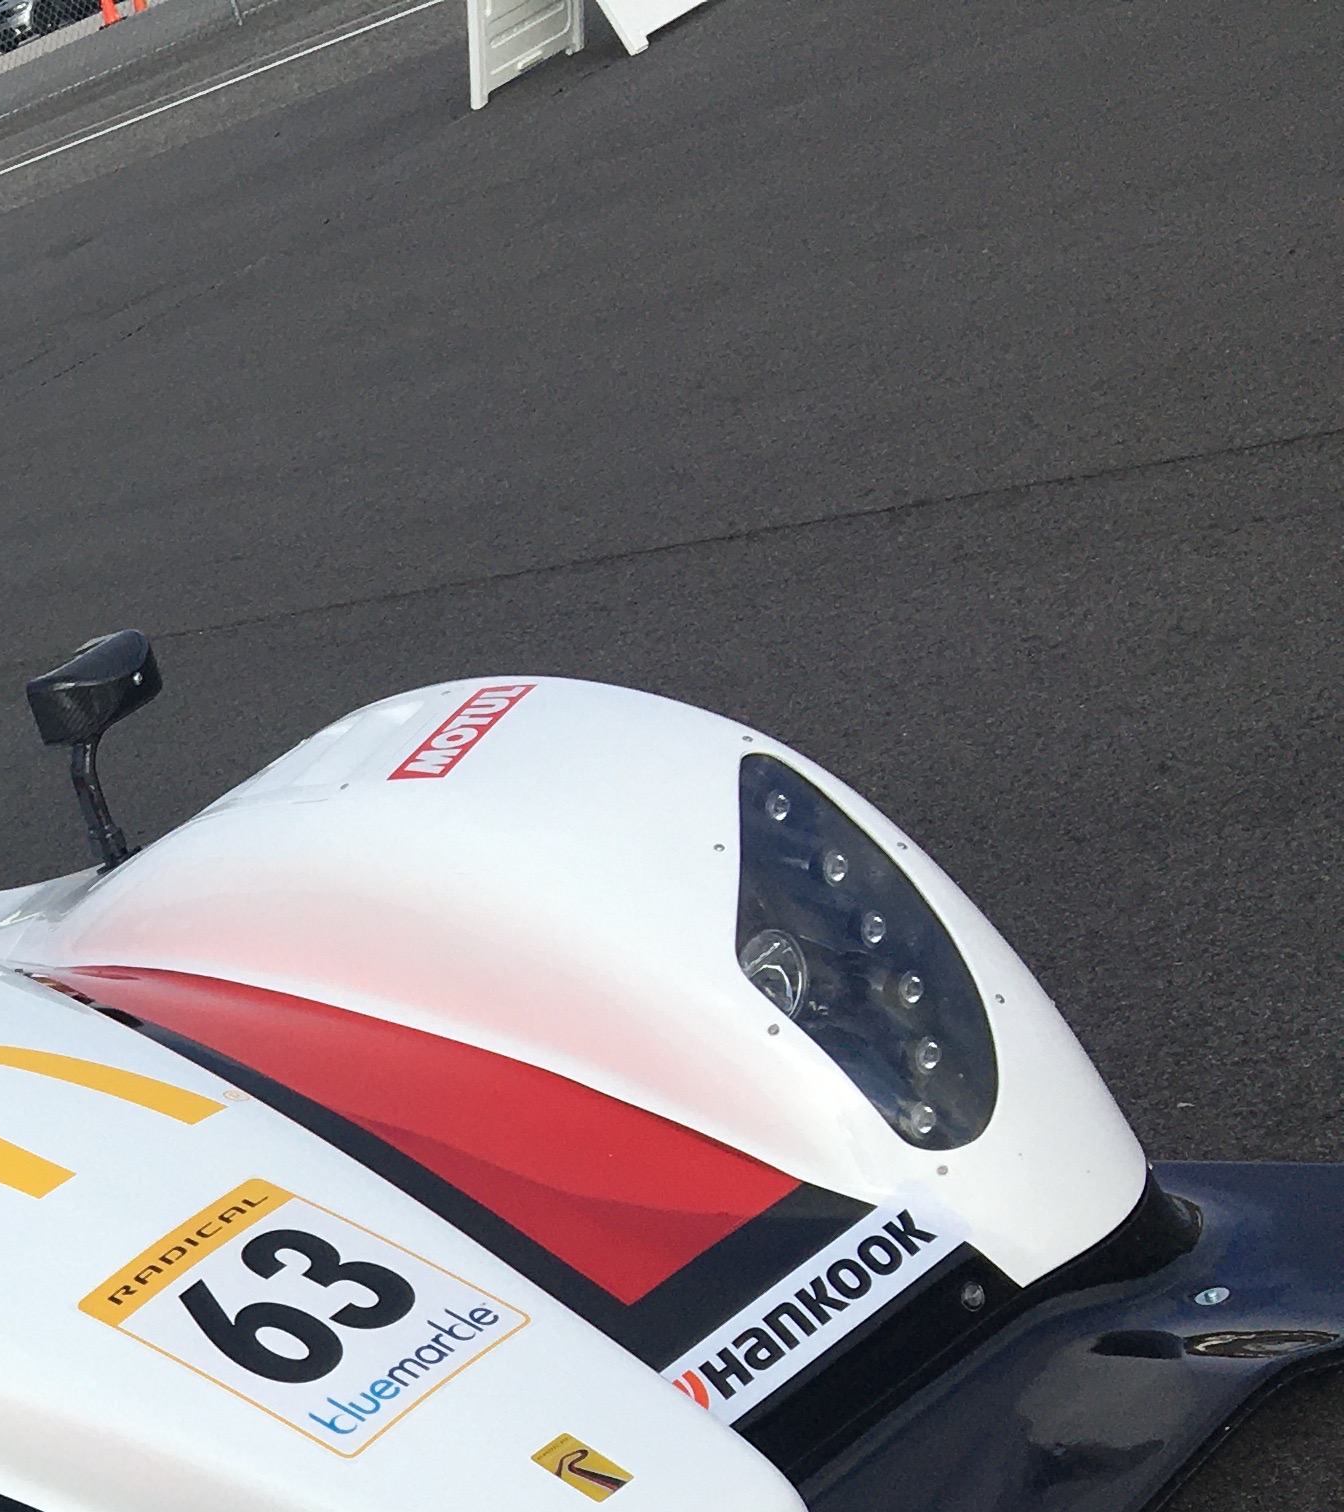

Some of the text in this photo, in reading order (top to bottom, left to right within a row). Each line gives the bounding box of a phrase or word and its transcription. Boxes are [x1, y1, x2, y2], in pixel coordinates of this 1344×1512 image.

[403, 685, 526, 774] MOTUL
[107, 1195, 269, 1306] RADICAL
[178, 1228, 416, 1385] 63
[308, 1303, 500, 1435] bluemarble
